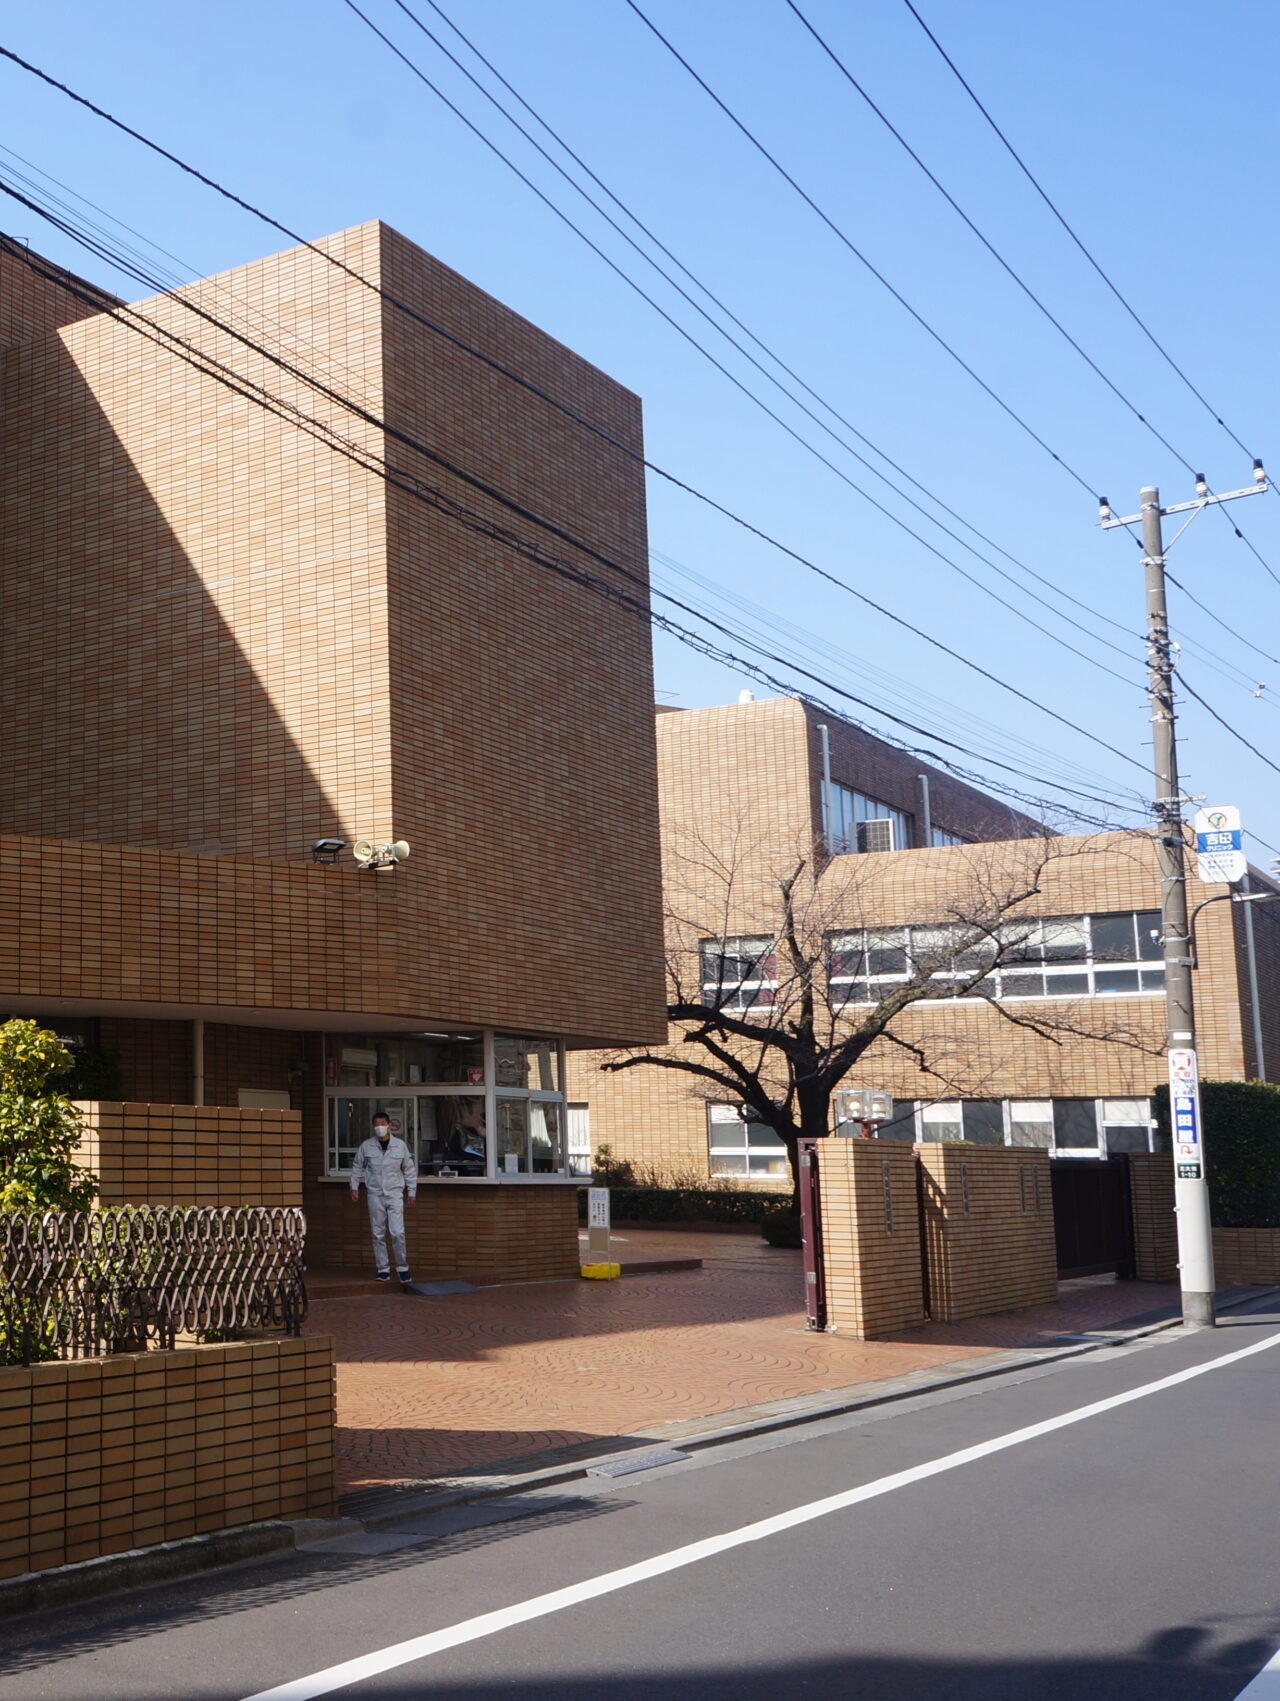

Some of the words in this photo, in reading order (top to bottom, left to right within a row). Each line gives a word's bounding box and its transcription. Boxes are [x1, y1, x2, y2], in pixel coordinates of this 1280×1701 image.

[1205, 832, 1233, 845] 吉田
[1206, 844, 1233, 852] クリニック
